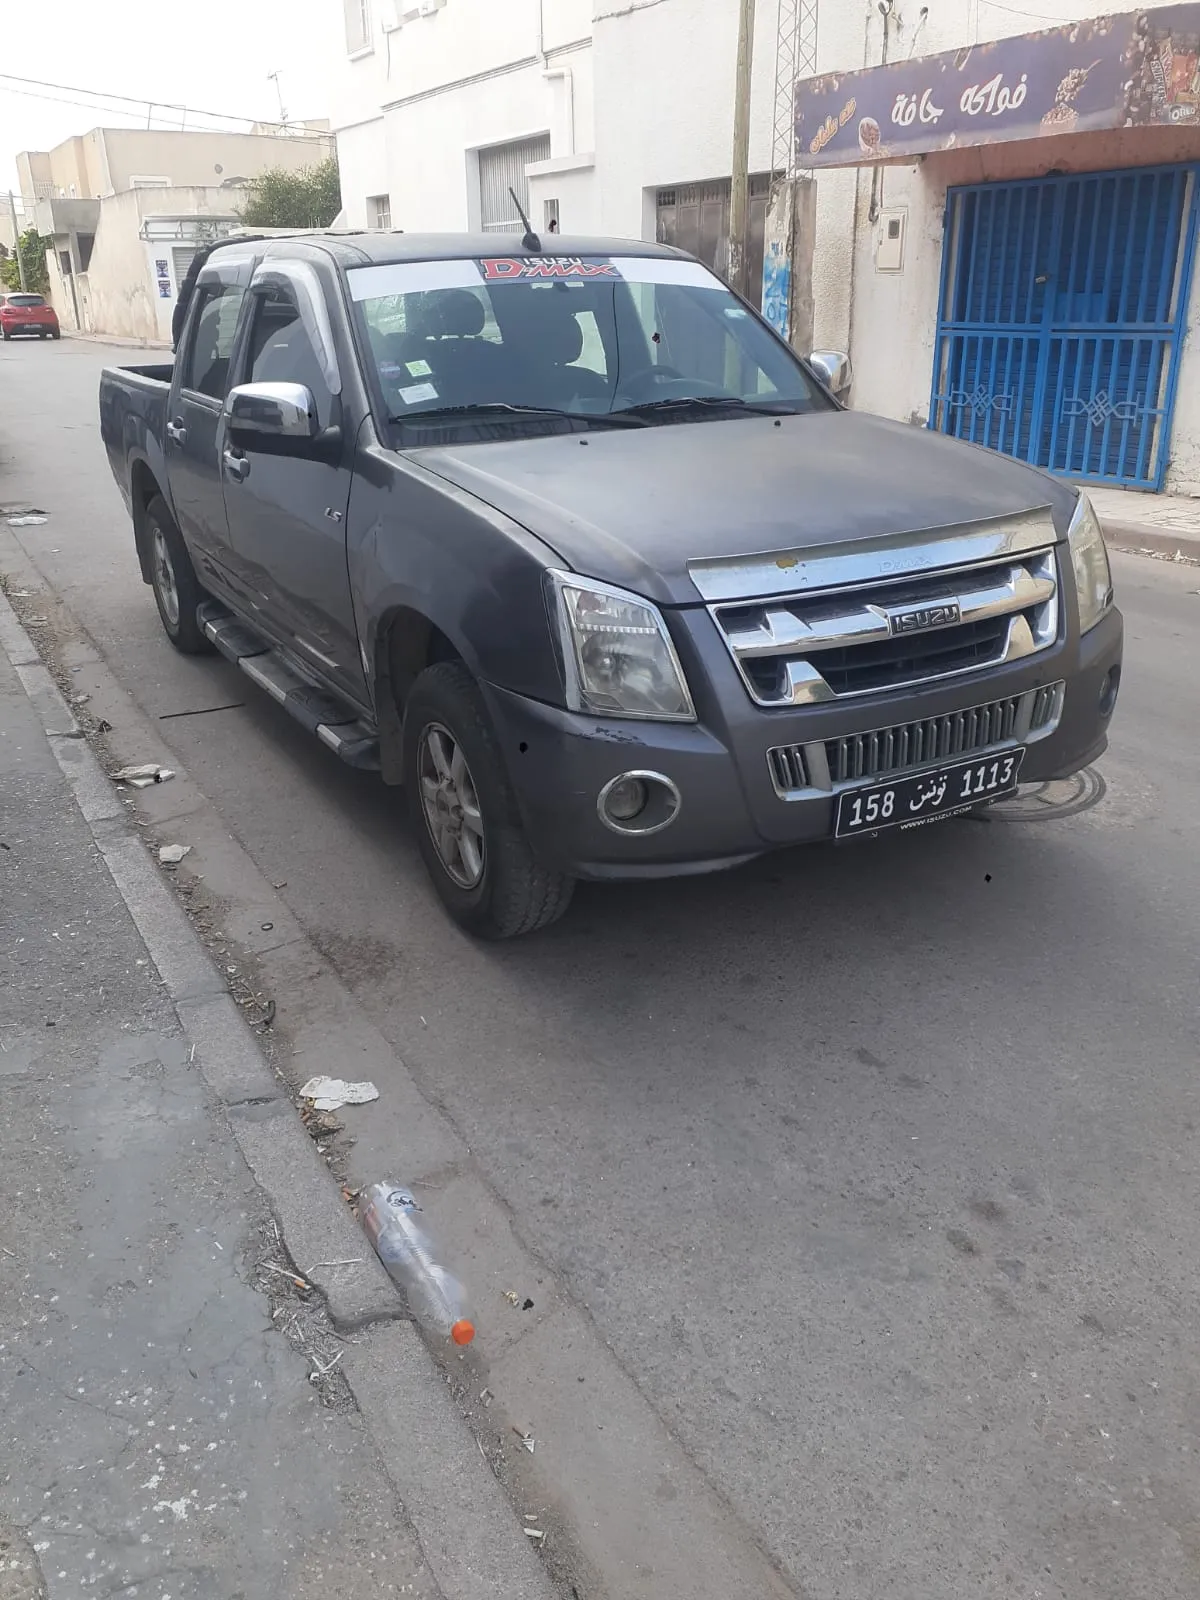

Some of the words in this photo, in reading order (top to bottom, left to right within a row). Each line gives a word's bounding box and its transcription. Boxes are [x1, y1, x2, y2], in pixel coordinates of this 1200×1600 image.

[891, 88, 944, 126] جافة
[523, 257, 582, 266] ISUZU
[895, 606, 958, 632] ISUZU
[849, 790, 895, 826] 158
[910, 775, 948, 811] تونس
[960, 757, 1015, 797] 1113
